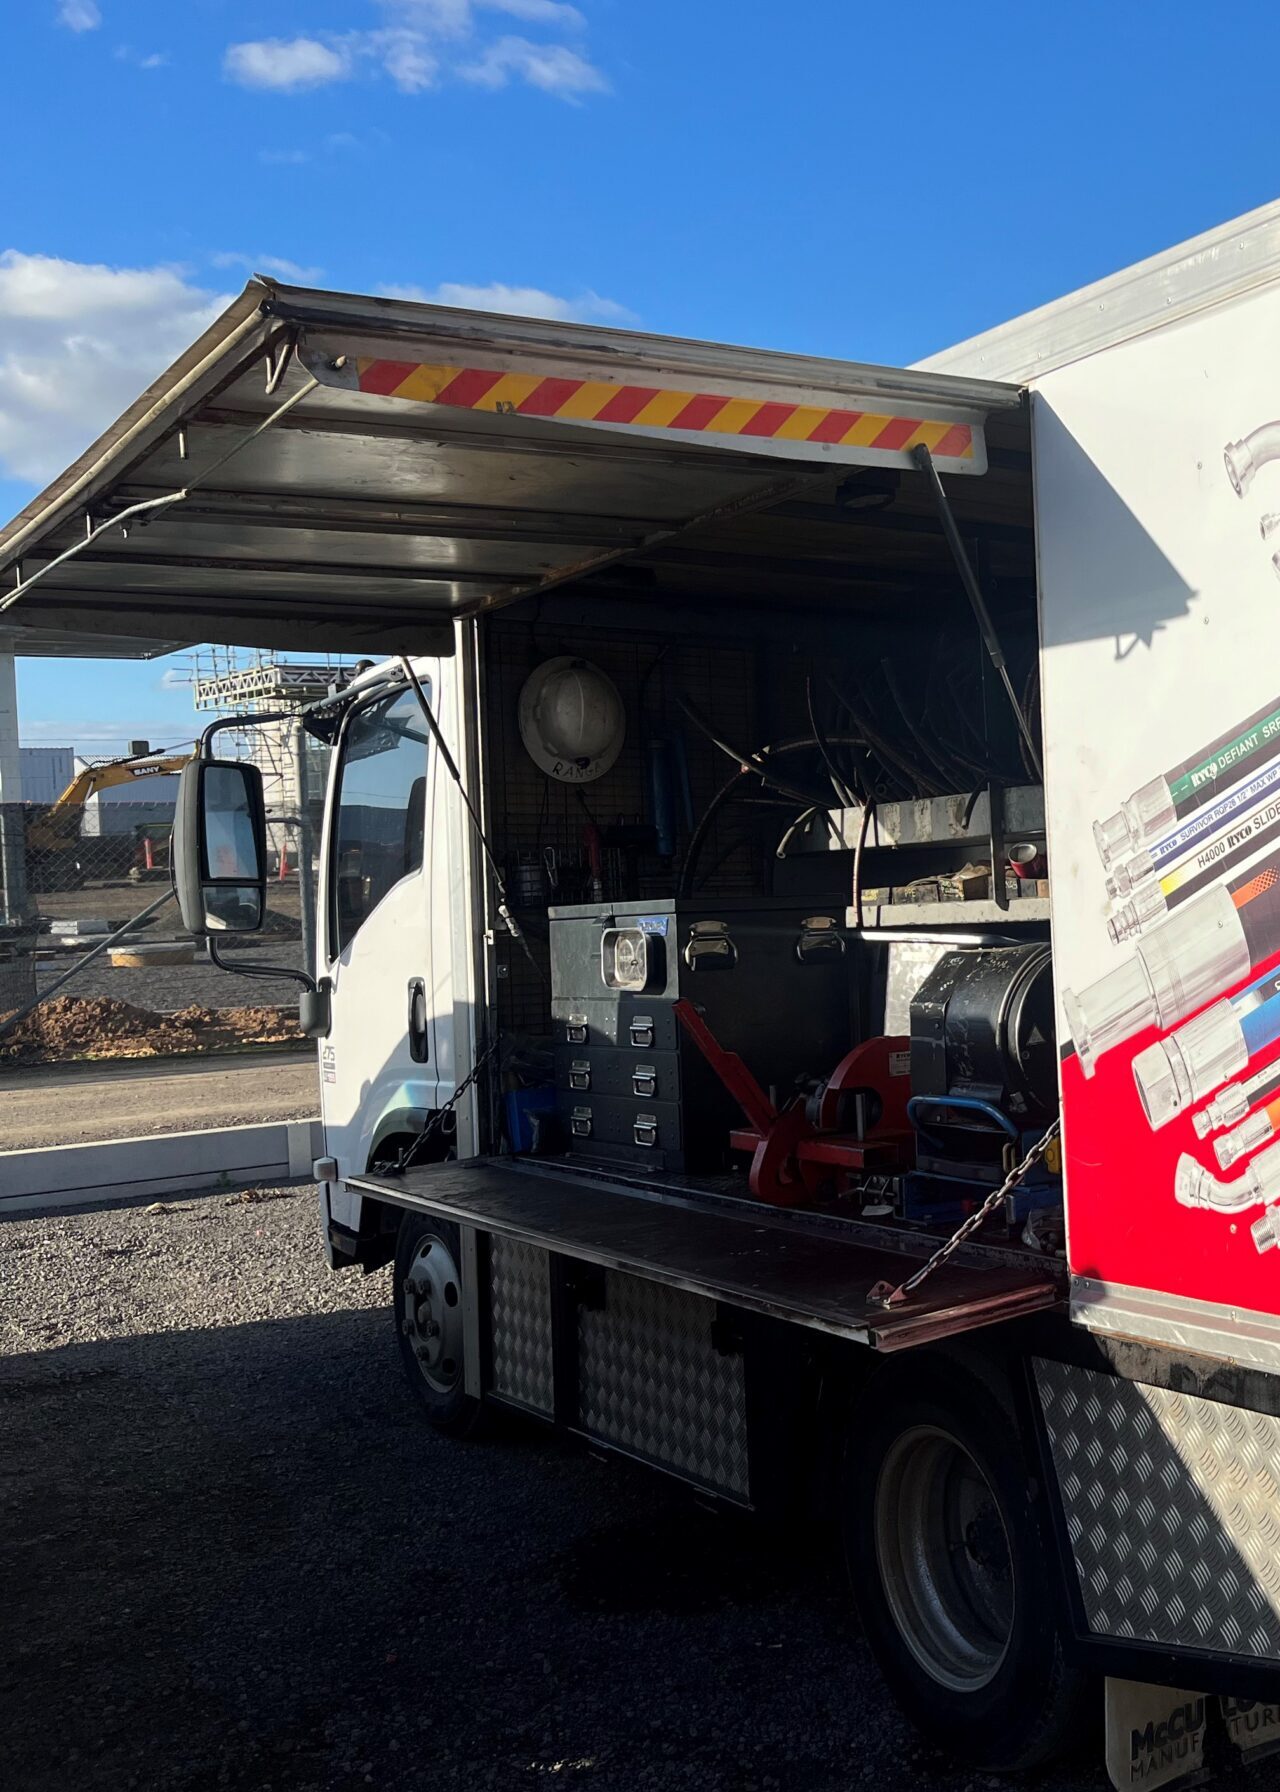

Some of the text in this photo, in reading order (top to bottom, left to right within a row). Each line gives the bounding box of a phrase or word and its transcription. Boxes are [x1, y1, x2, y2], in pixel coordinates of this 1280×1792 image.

[1191, 762, 1218, 788] RYCO
[1218, 733, 1259, 769] DEFIANT
[1180, 816, 1214, 847] SURVIVOR
[1249, 780, 1267, 800] MAX
[1265, 770, 1280, 788] WP
[1197, 842, 1226, 869] H4000
[1226, 825, 1252, 852] RYCO
